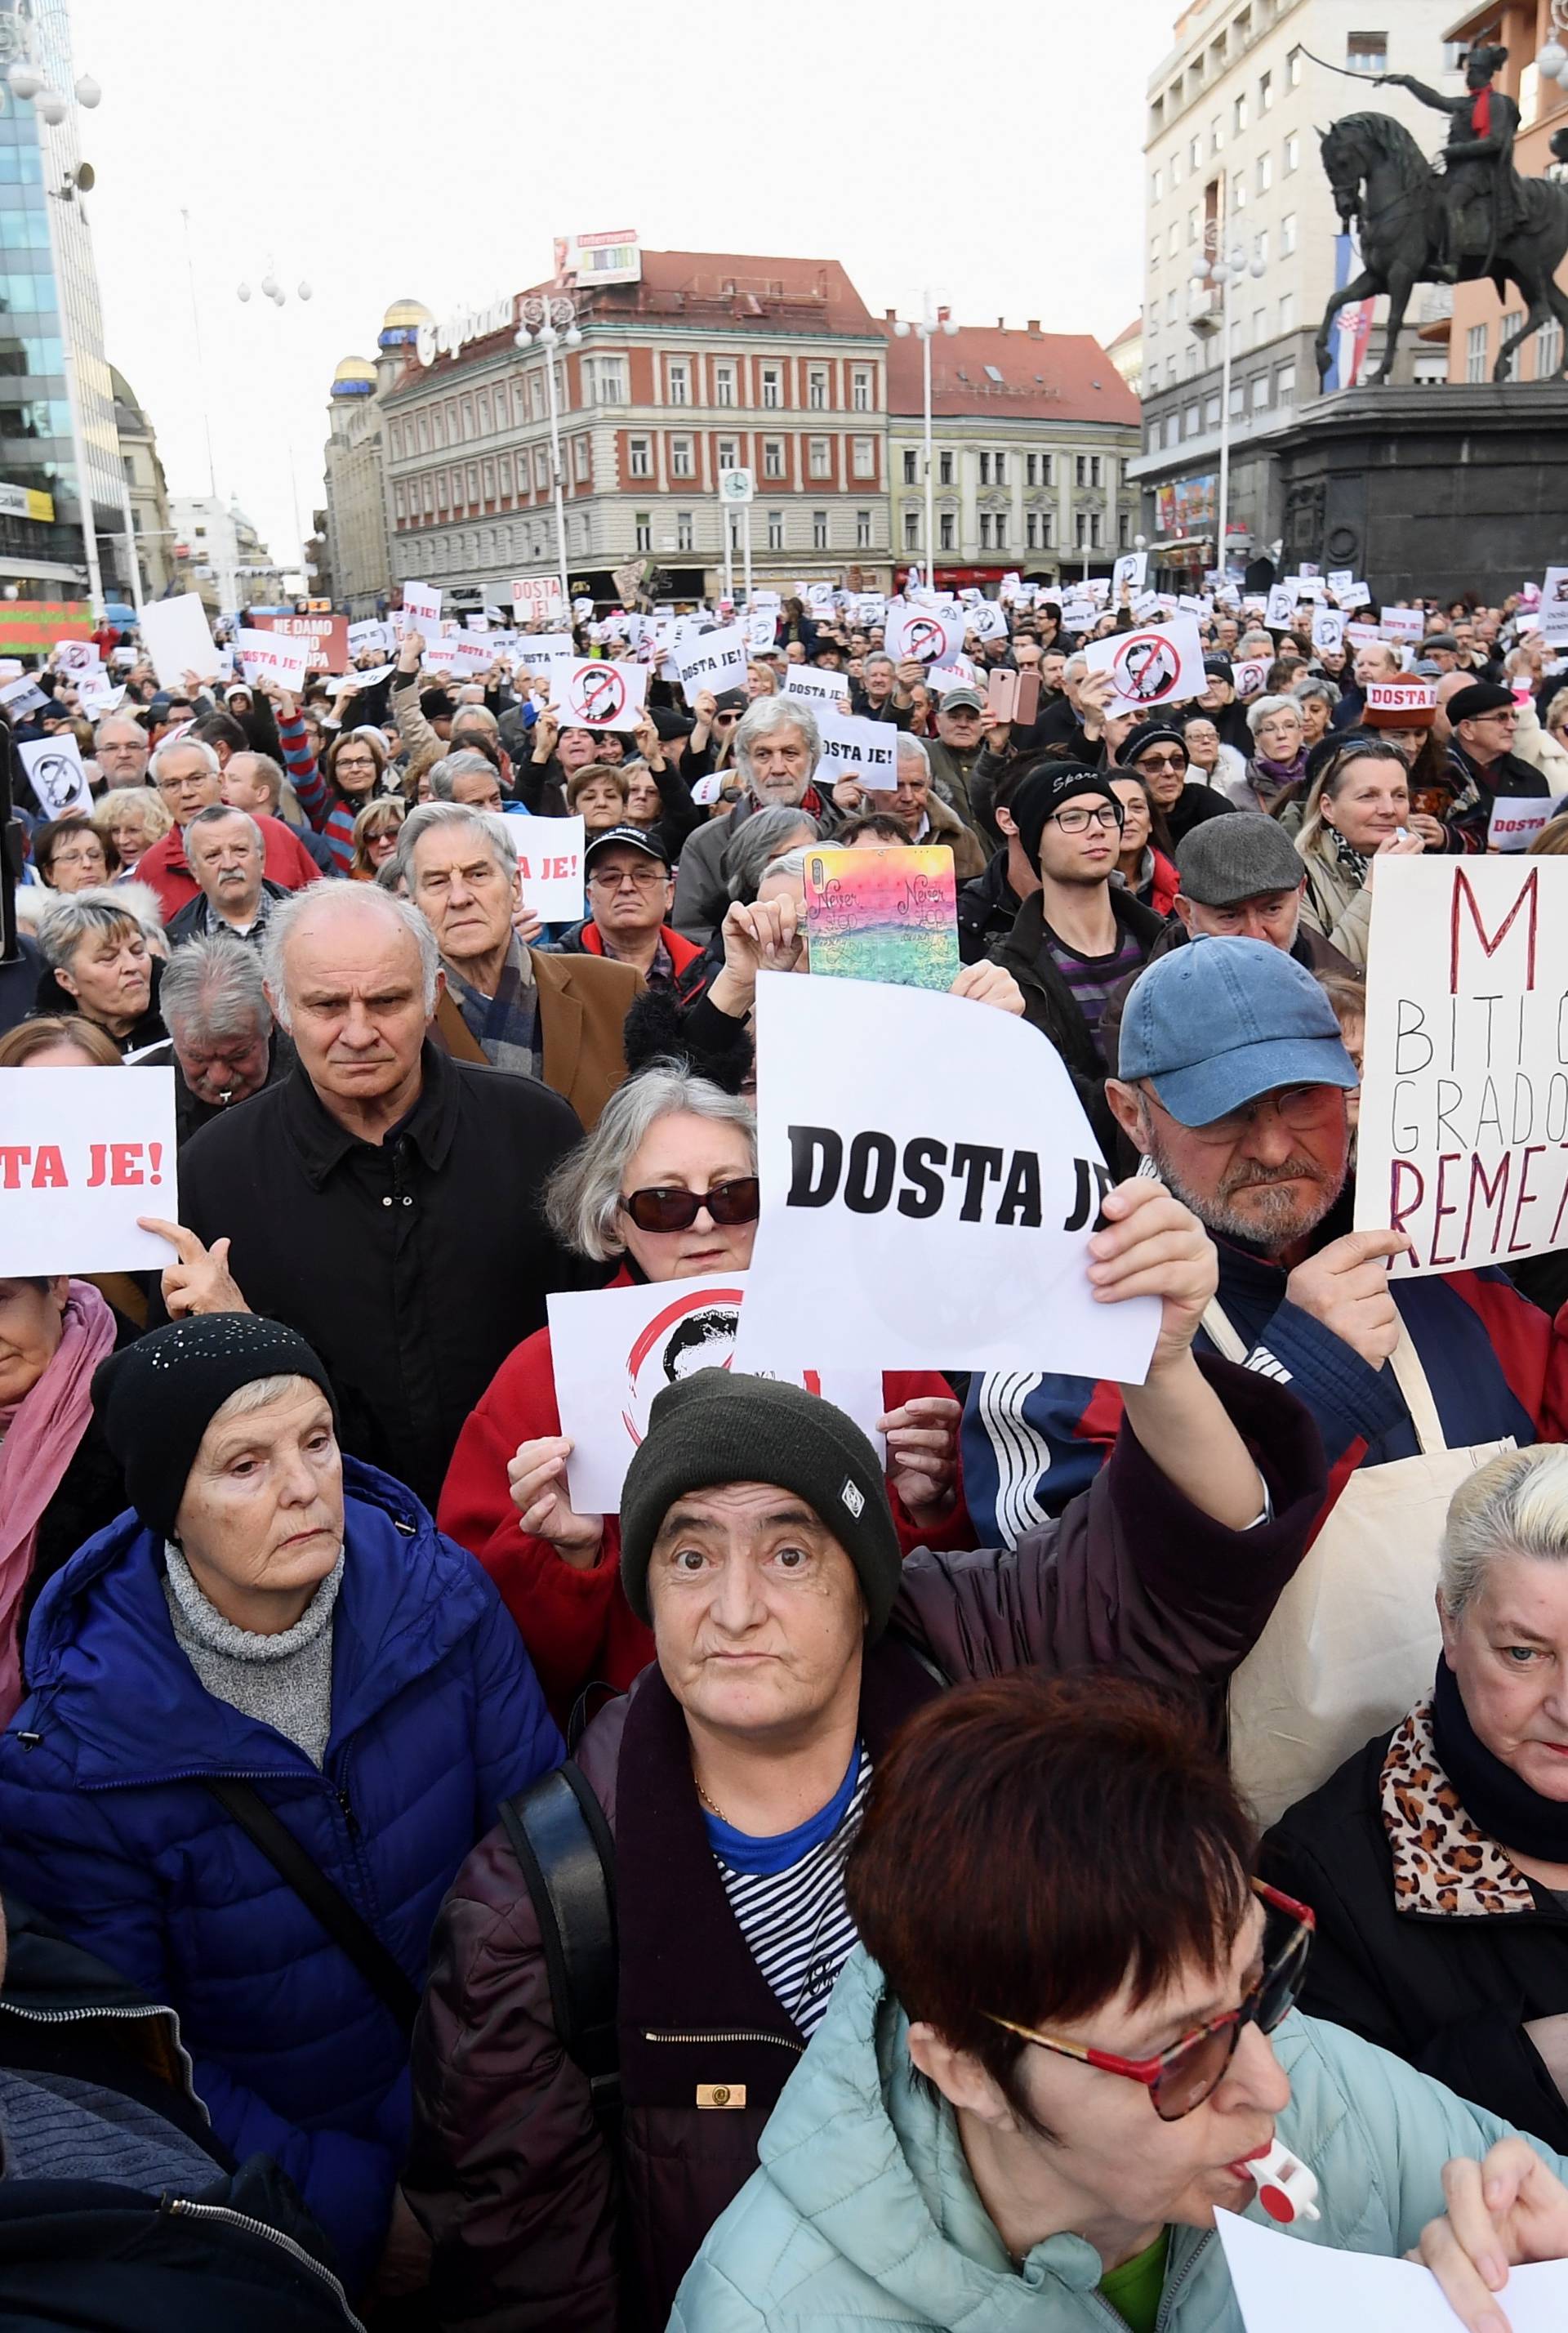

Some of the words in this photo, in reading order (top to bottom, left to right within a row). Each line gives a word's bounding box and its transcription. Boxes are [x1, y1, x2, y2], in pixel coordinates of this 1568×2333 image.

[513, 580, 559, 600] DOSTA
[421, 607, 437, 618] JE!
[293, 618, 333, 636] DAMO
[457, 644, 484, 658] DOSTA
[282, 657, 303, 671] JE!
[681, 658, 717, 681] DOSTA
[722, 649, 742, 667] JE!
[788, 682, 826, 698] DOSTA
[1371, 689, 1427, 705] DOSTA
[823, 739, 862, 762] OSTA
[866, 747, 893, 765] JE!
[1494, 818, 1546, 832] DOSTA
[541, 854, 578, 881] JE!
[808, 878, 859, 920] Never
[898, 874, 946, 915] Never
[1395, 994, 1525, 1076] BITI
[87, 1141, 163, 1188] JE!
[786, 1125, 1042, 1229] DOSTA
